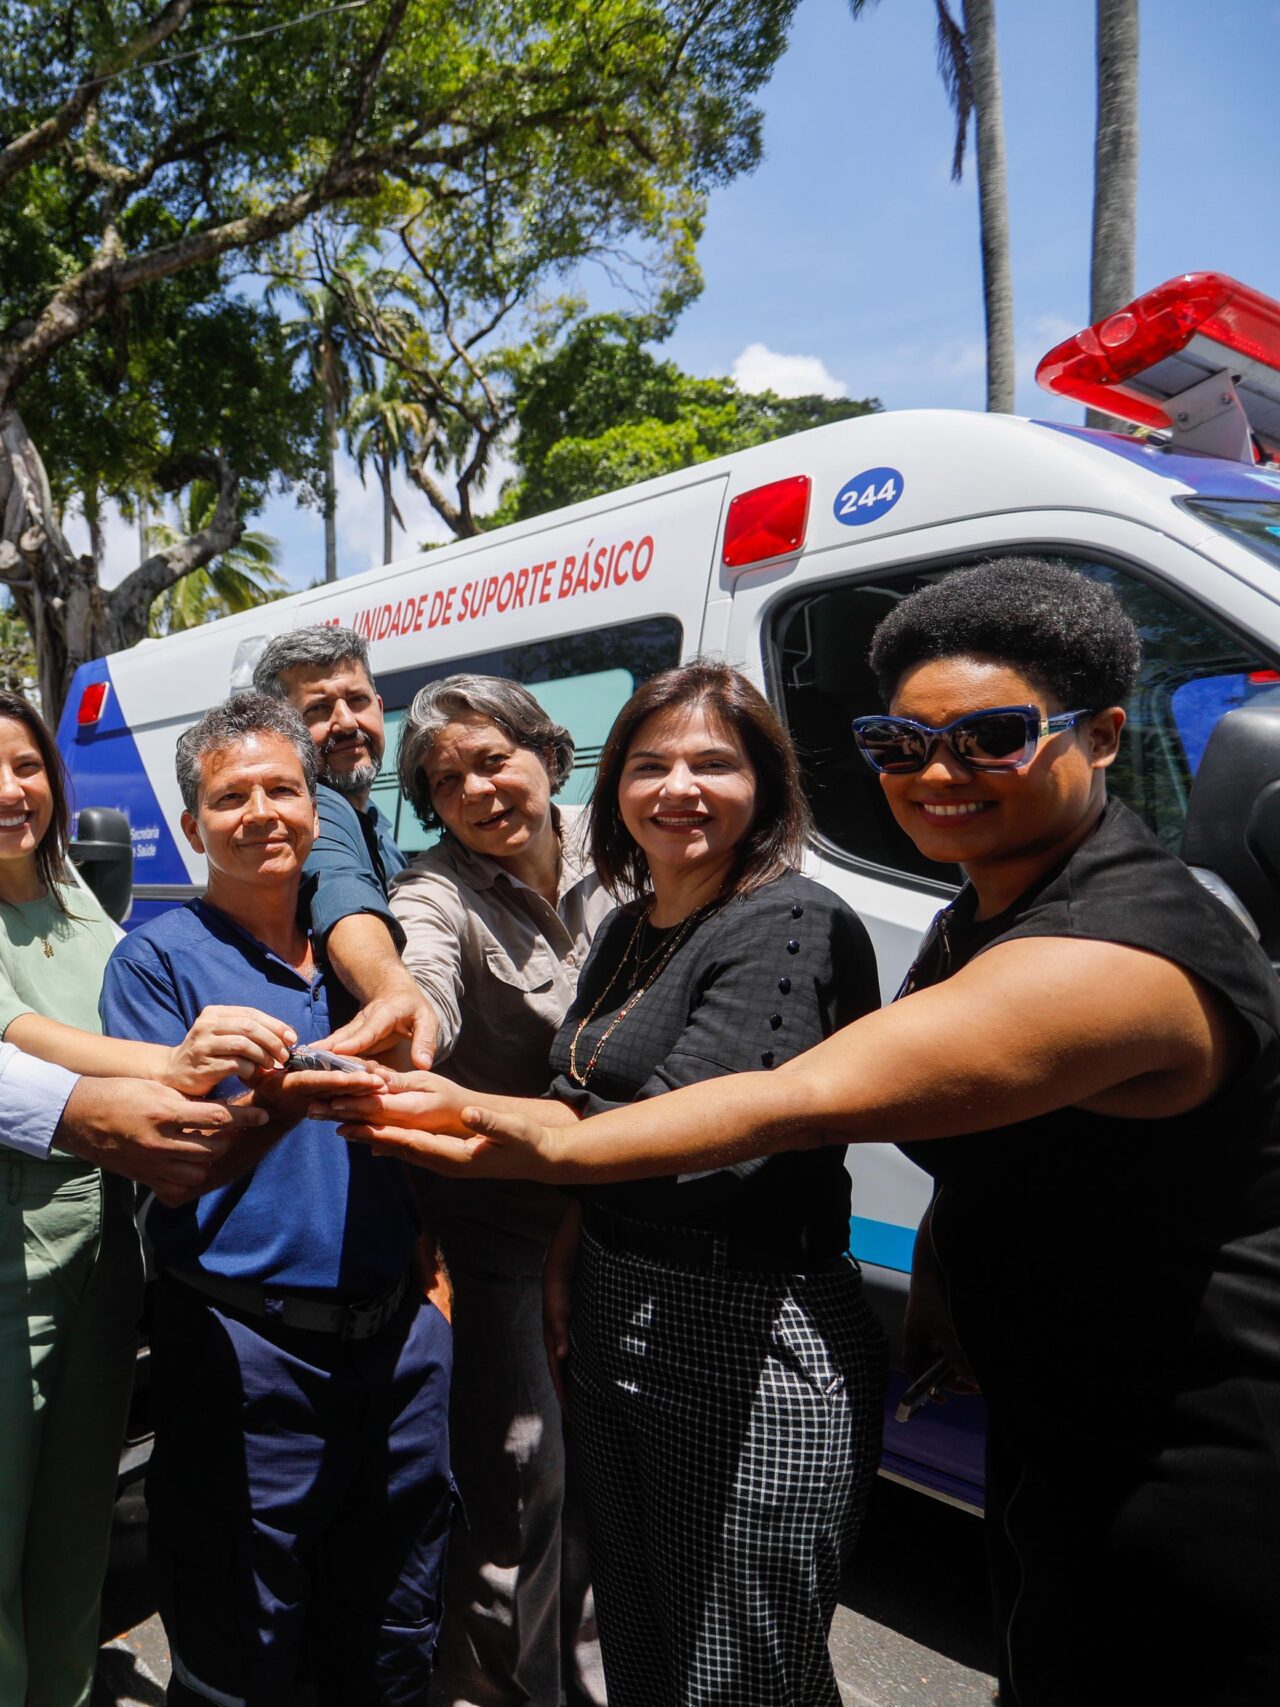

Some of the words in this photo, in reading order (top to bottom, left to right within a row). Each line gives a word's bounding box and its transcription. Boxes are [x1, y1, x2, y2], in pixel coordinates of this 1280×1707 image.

[840, 478, 896, 515] 244
[352, 594, 428, 642] UNIDADE
[428, 586, 457, 629] DE
[457, 560, 557, 622] SUPORTE
[558, 535, 655, 599] BÁSICO
